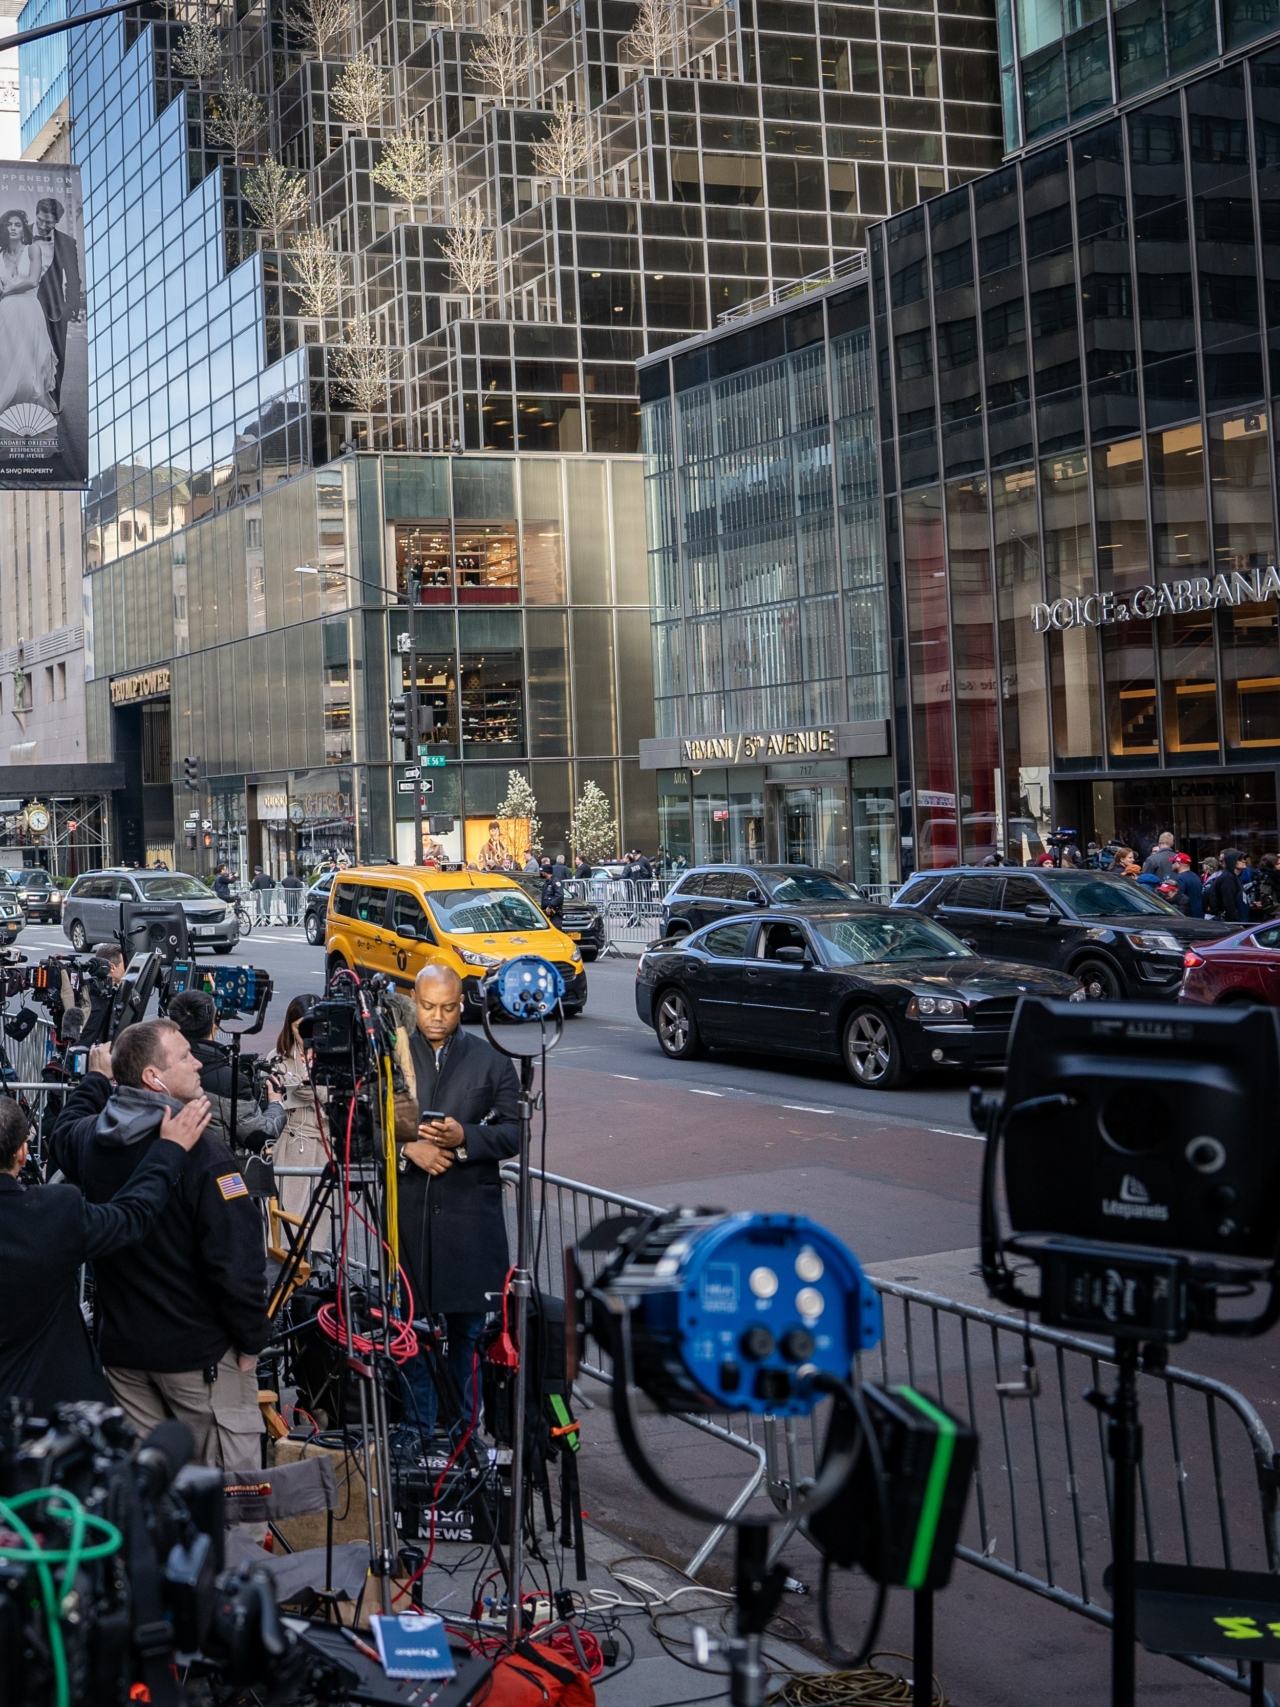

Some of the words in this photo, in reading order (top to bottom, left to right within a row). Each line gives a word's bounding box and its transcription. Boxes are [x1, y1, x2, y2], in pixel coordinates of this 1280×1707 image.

[18, 185, 74, 194] AVENUE
[110, 676, 138, 702] TRUMP
[138, 668, 170, 696] TOWER
[682, 738, 734, 761] ARMANI
[766, 730, 835, 756] AVENUE
[432, 757, 439, 765] 56
[799, 765, 812, 776] 717
[264, 795, 287, 808] GUCCI
[305, 793, 351, 814] GUCCI
[399, 953, 405, 968] T
[418, 1526, 473, 1541] NEWS
